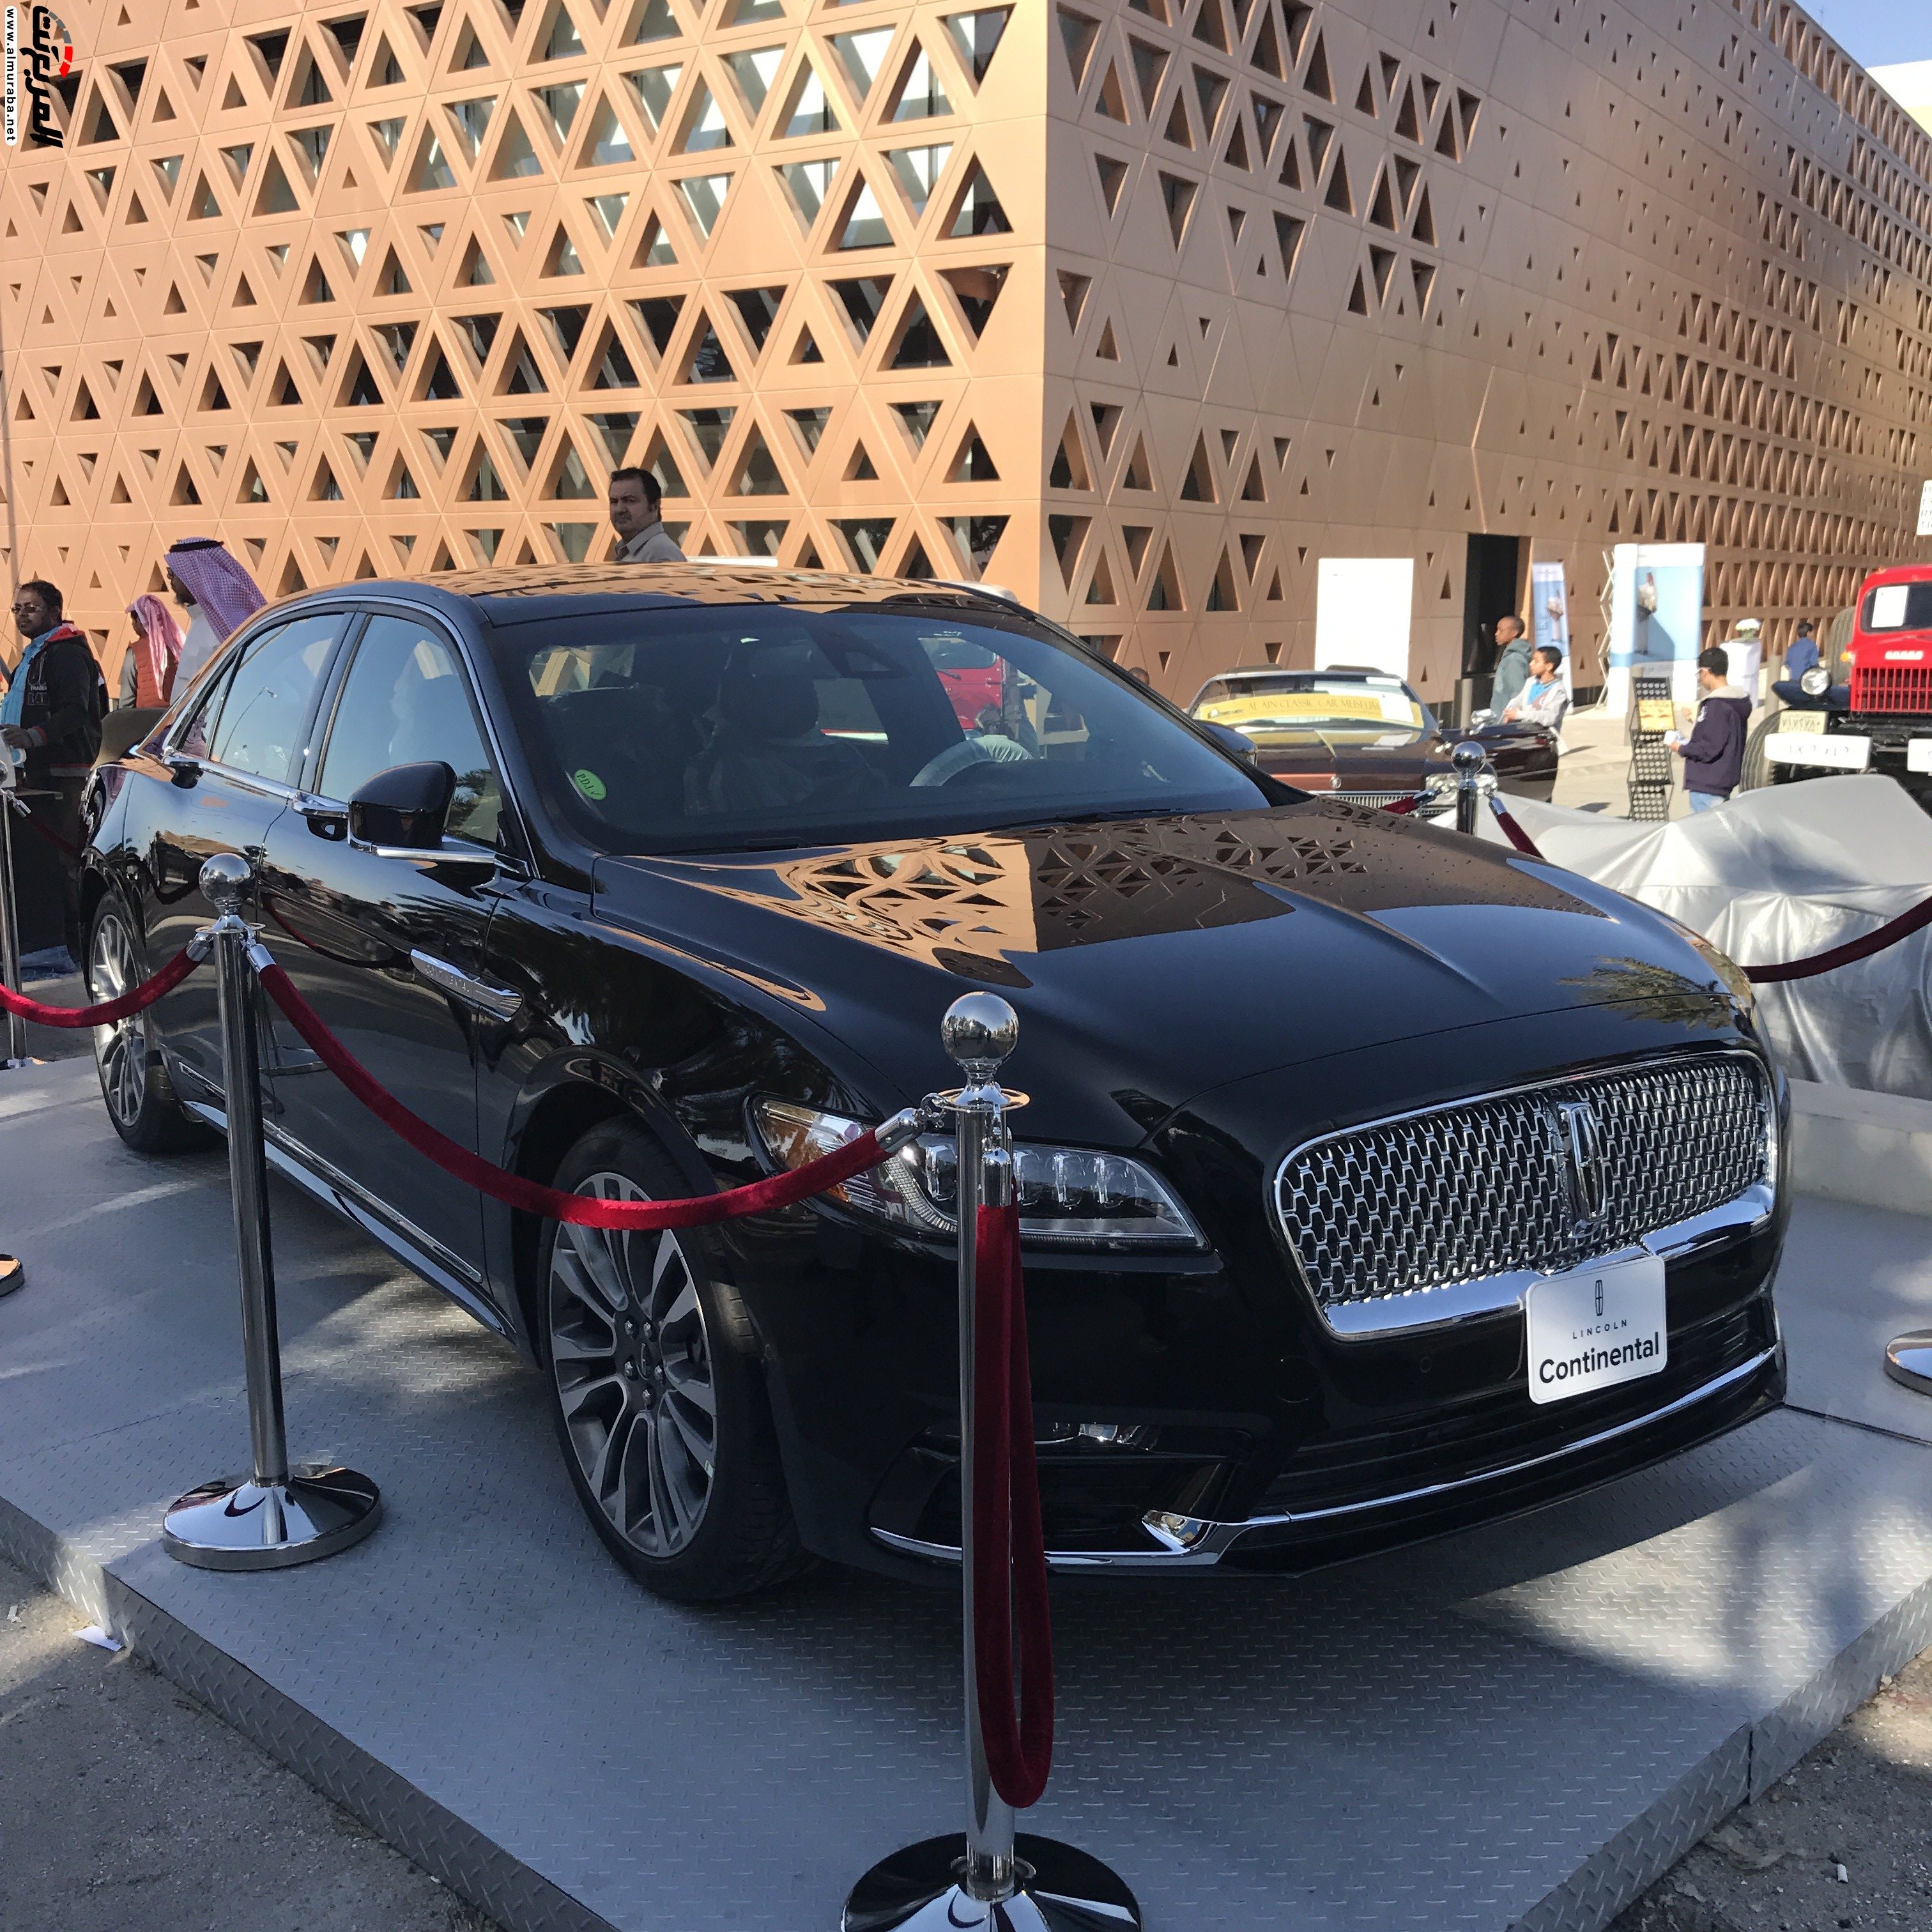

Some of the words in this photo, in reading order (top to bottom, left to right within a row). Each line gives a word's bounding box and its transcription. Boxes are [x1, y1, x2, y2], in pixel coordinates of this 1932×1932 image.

[1248, 702, 1257, 710] AL
[1262, 700, 1278, 710] AIN
[1279, 698, 1313, 709] CLASSIC
[1318, 698, 1338, 708] CAR
[1340, 698, 1380, 710] MUSEUM
[1572, 1319, 1627, 1340] LINCOLN
[1539, 1331, 1659, 1384] Continental
